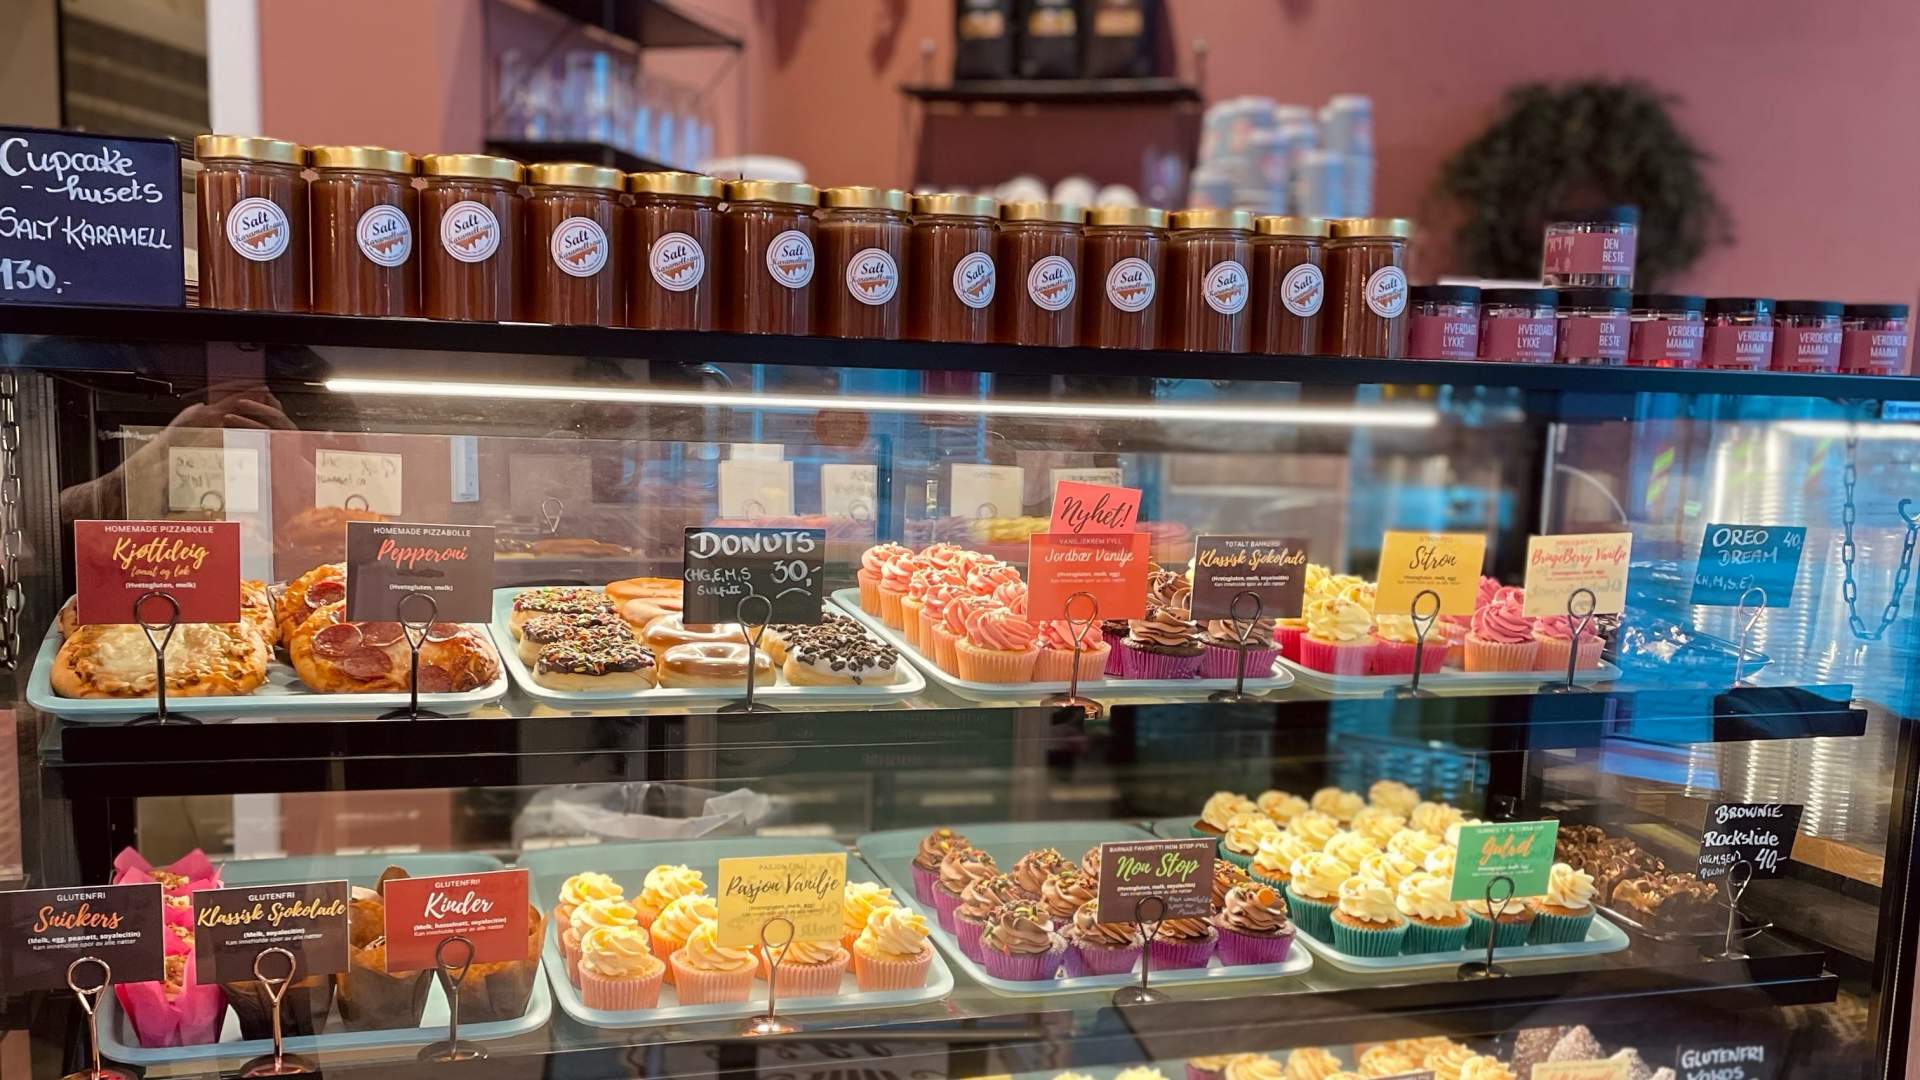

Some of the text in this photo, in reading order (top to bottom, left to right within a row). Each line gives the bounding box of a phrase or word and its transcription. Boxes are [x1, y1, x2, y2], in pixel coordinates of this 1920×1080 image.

[0, 138, 136, 181] Cupcake
[45, 175, 163, 204] husets
[0, 207, 172, 250] SALT KARAMELL
[242, 211, 270, 231] Salt
[372, 218, 397, 236] Salt
[454, 214, 479, 233] Salt
[565, 230, 589, 249] Salt
[1603, 238, 1619, 250] DEN
[663, 245, 687, 263] Salt
[781, 245, 804, 257] Salt
[1602, 251, 1625, 263] BESTE
[861, 263, 885, 275] Salt
[966, 264, 985, 284] Salt
[1041, 268, 1064, 283] Salt
[1120, 271, 1143, 284] Salt
[1216, 274, 1238, 288] Salt
[1293, 277, 1314, 293] Salt
[1377, 278, 1398, 293] Salt
[1600, 322, 1615, 335] DEN
[1667, 324, 1699, 337] VERDENS
[1737, 330, 1767, 342] VERDENS
[1443, 336, 1465, 348] LYKKE
[1517, 336, 1541, 349] LYKKE
[1599, 334, 1621, 347] BESTE
[1666, 338, 1694, 349] MAMMA
[1799, 332, 1833, 344] VERDENS
[1872, 335, 1901, 346] VERDENS
[1736, 343, 1764, 353] MAMMA
[1798, 345, 1829, 355] MAMMA
[1870, 347, 1898, 358] MAMMA
[1060, 493, 1133, 534] Nyhet!
[104, 525, 214, 534] HOMEMADE PIZZABOLLE
[373, 527, 471, 537] HOMEMADE PIZZABOLLE
[1713, 528, 1769, 547] OREO
[689, 531, 815, 559] DONUTS
[112, 537, 210, 570] Kjøttdeig
[377, 539, 468, 570] Pepperoni
[1045, 547, 1134, 568] Jordbær Vanilje
[1198, 547, 1306, 571] Klassisk Sjokolade
[1409, 545, 1456, 571] Sitron
[1718, 546, 1778, 567] DREAM
[1715, 804, 1783, 824] BROWNIE
[1116, 852, 1200, 883] Non Stop
[435, 879, 479, 888] GLUTENFRI
[726, 869, 839, 904] Pasjon Vanilje
[56, 892, 106, 902] GLUTENFRI
[248, 892, 296, 901] GLUTENFRI
[197, 898, 346, 927] Klassisk Sjokolade
[424, 891, 493, 919] Kinder
[33, 903, 124, 933] Snickers
[1681, 1045, 1764, 1069] GLUTENFRI
